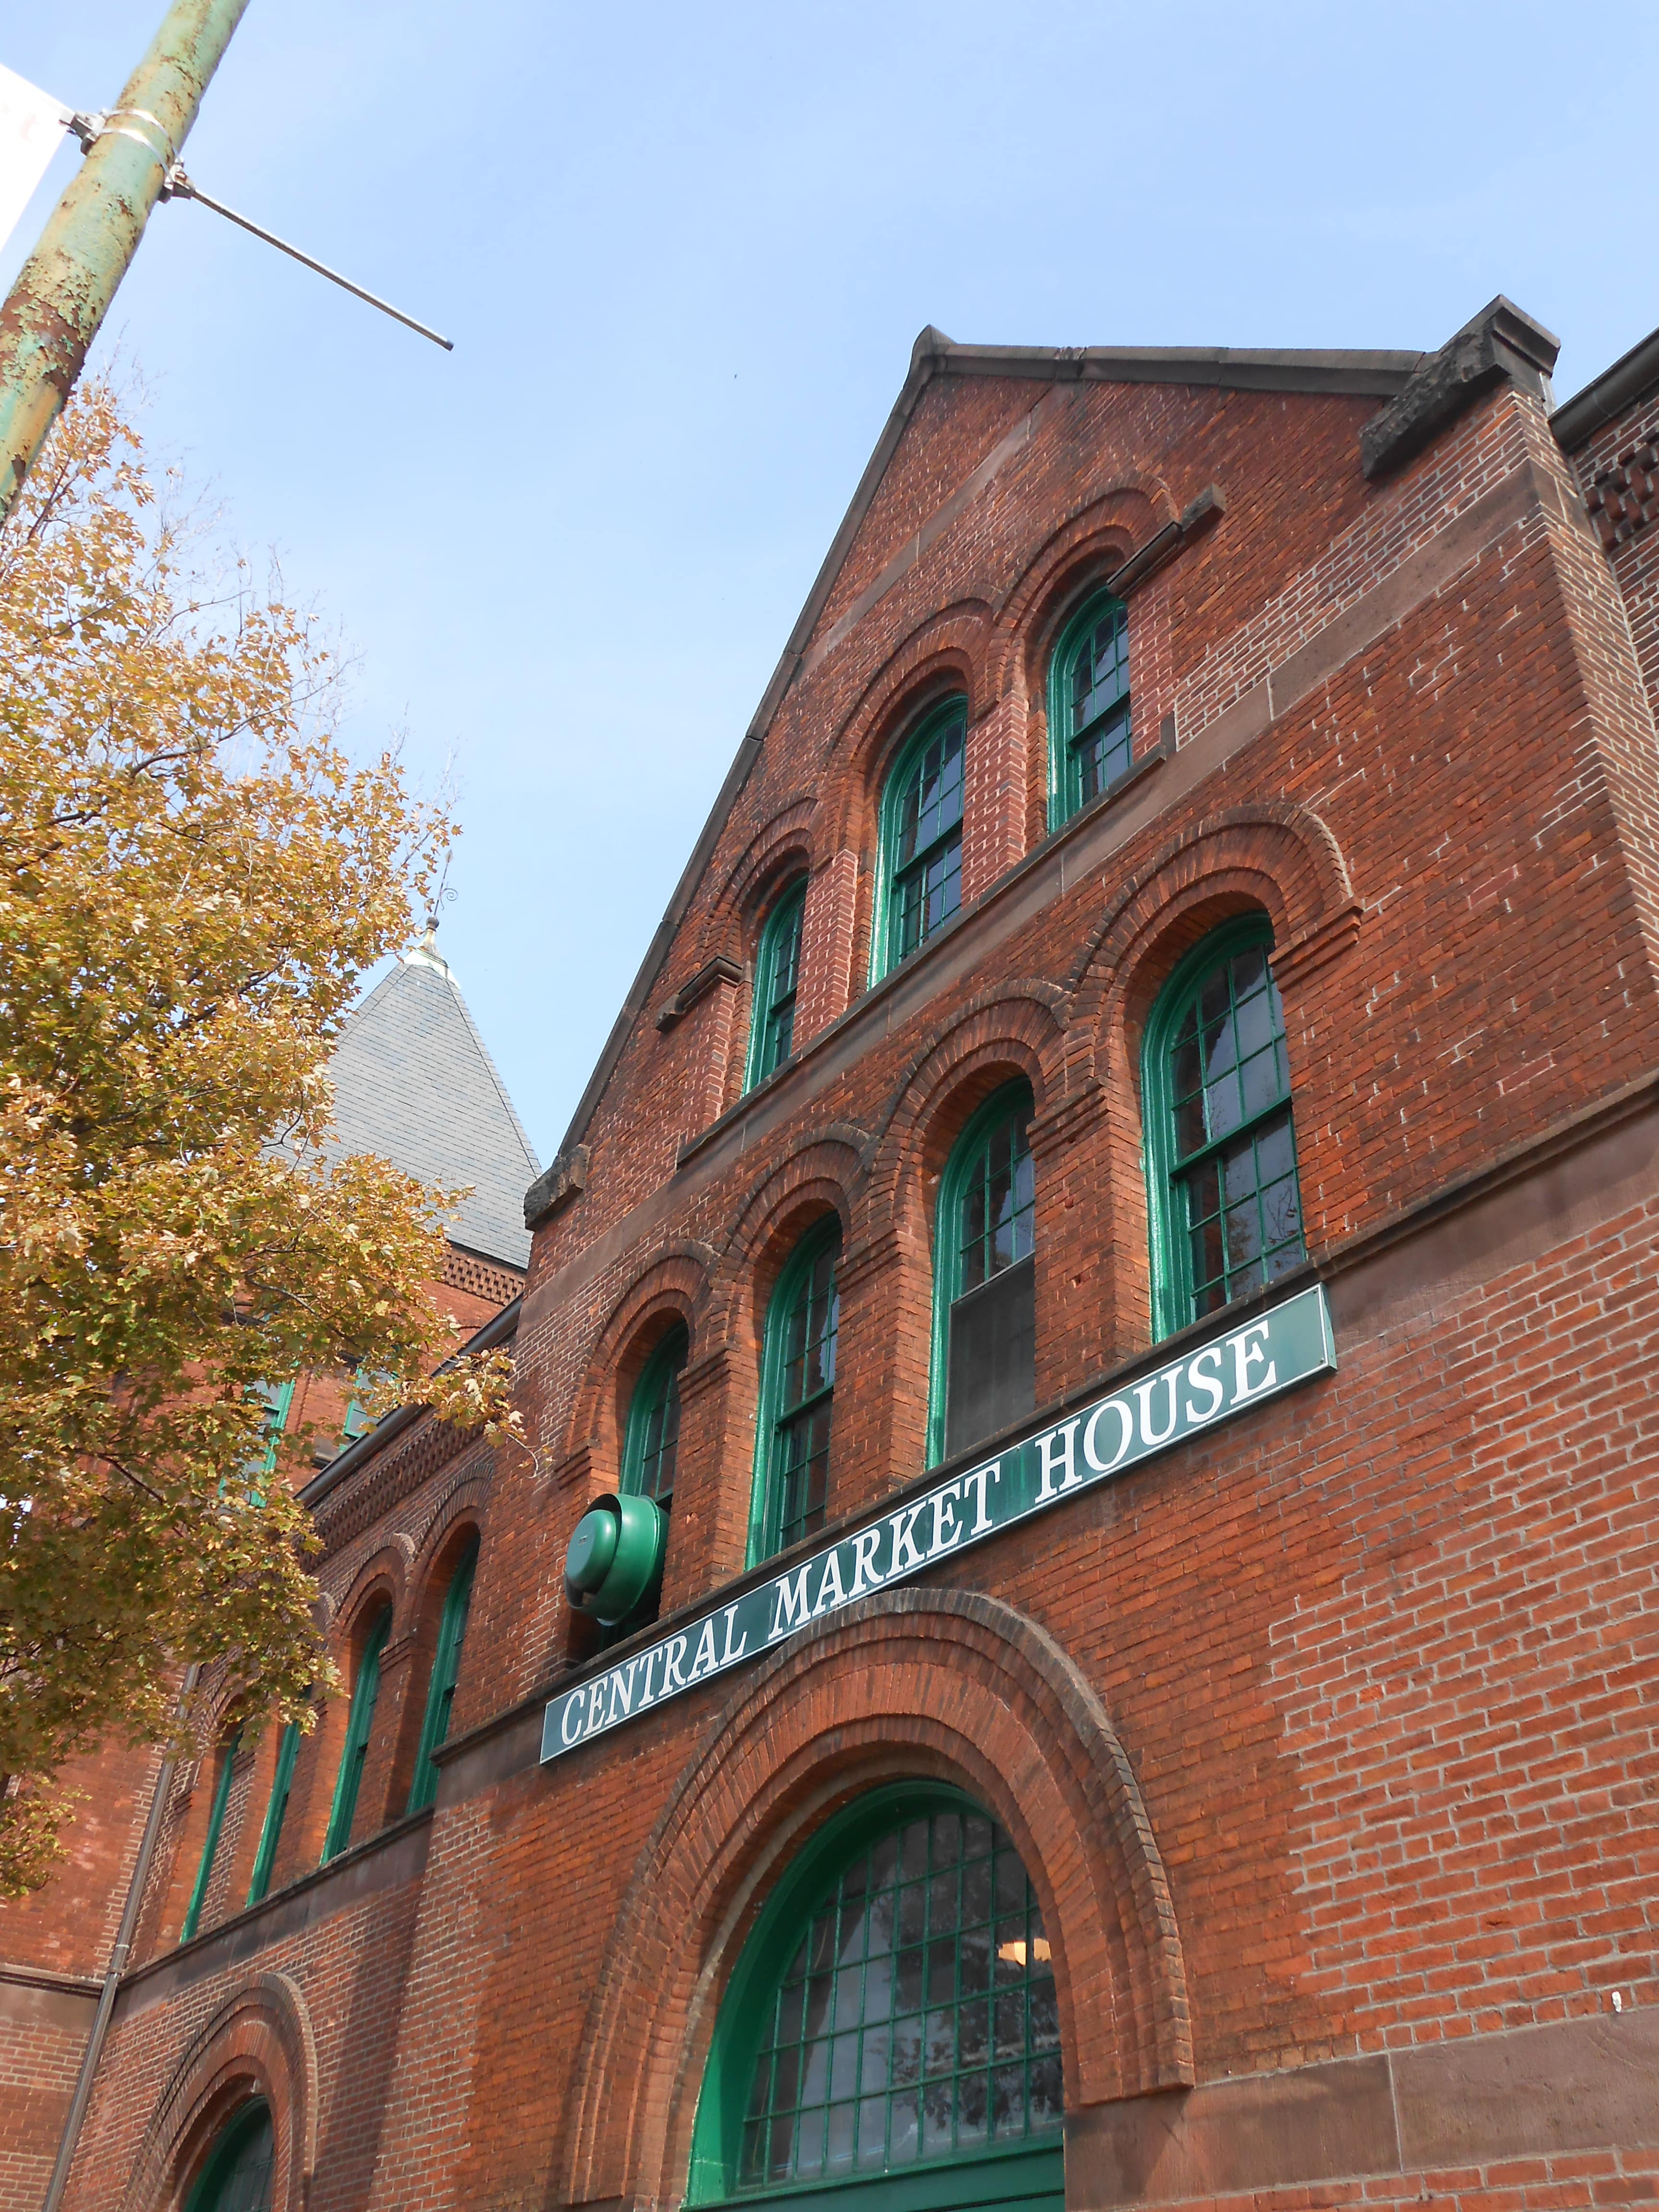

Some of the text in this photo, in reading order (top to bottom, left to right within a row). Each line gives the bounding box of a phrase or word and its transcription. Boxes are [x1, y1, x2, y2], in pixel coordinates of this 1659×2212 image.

[561, 1319, 1277, 1745] CENTRAL MARKET HOUSE
